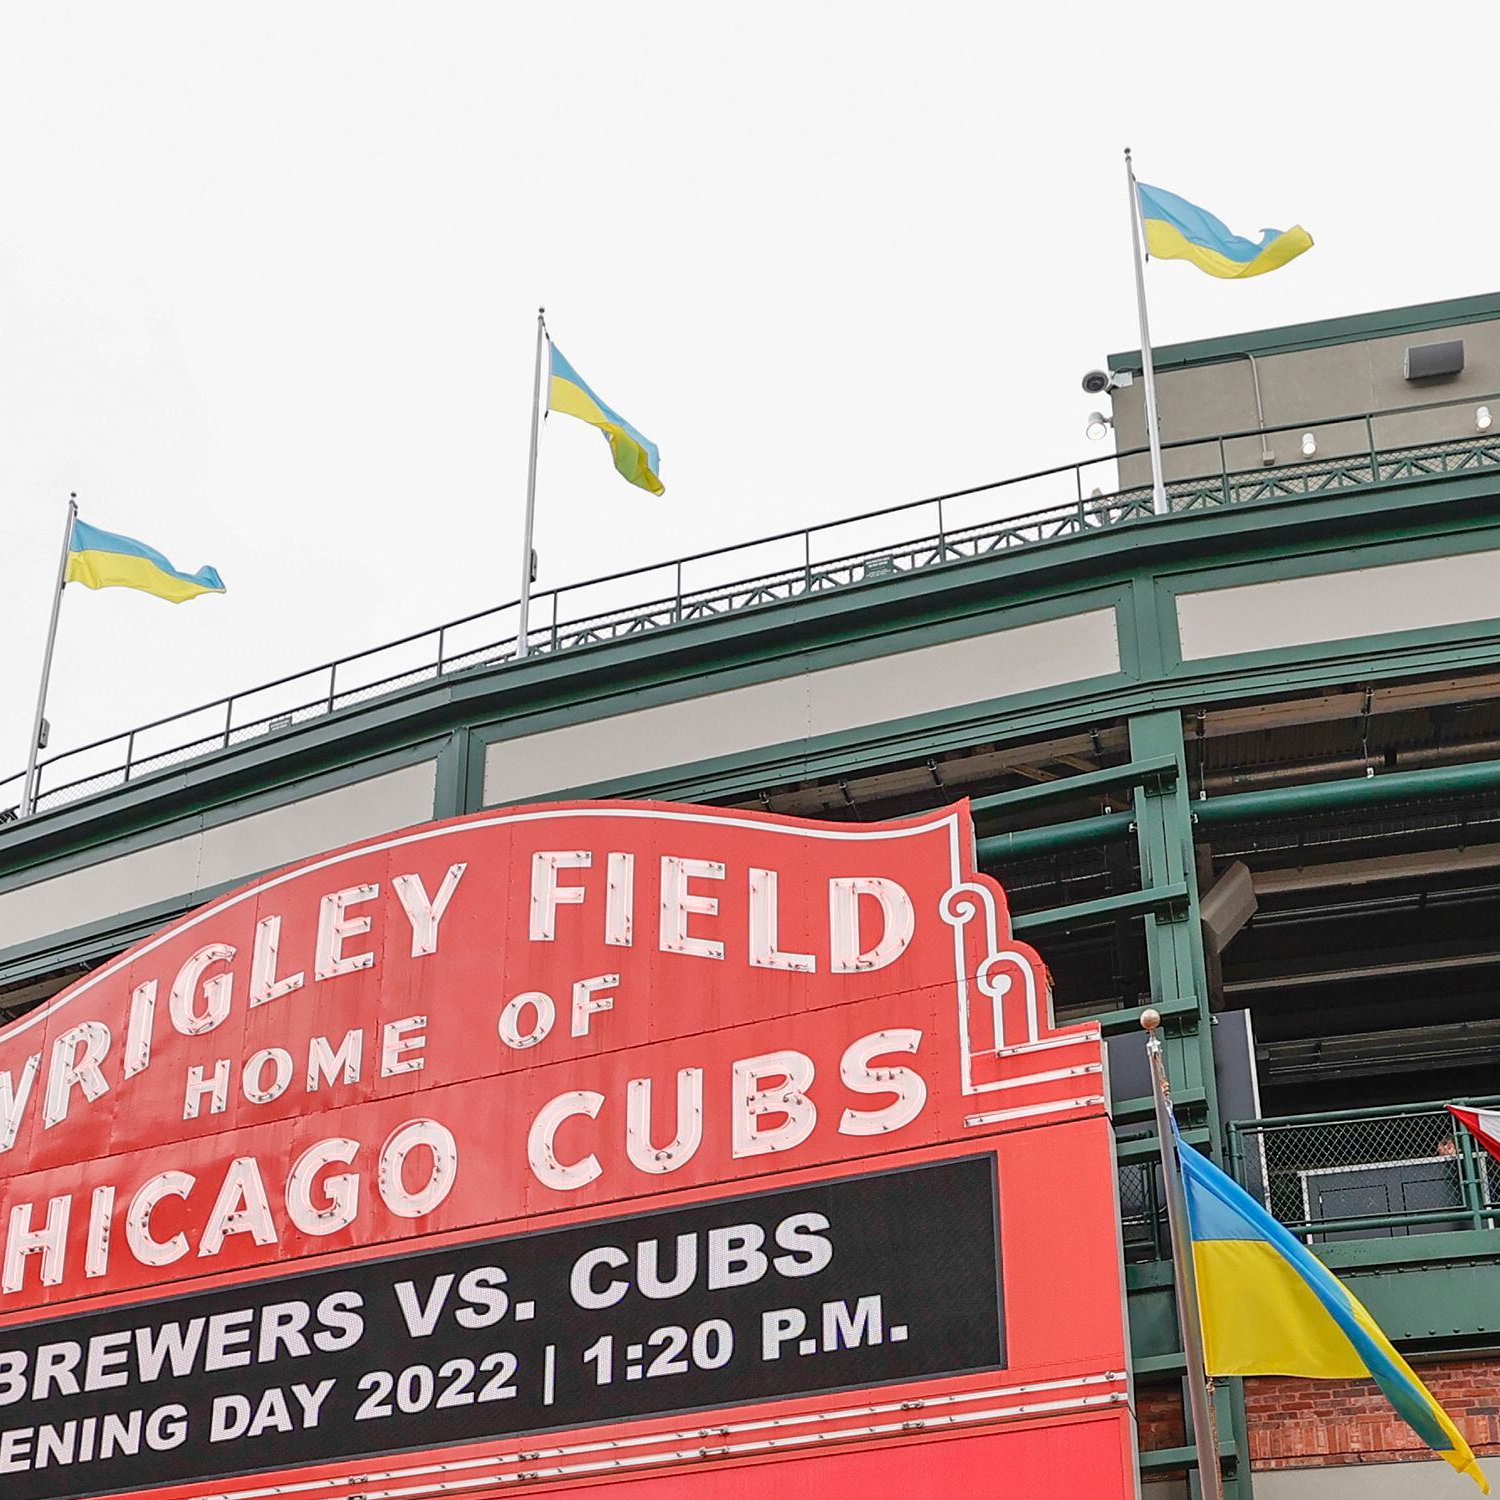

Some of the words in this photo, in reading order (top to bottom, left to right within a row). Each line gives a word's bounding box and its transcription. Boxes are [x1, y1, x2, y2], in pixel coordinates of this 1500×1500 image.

[528, 850, 917, 973] FIELD
[183, 1014, 428, 1120] HOME
[498, 973, 621, 1050] OF
[526, 1027, 929, 1192] CUBS
[393, 1265, 536, 1339] VS.
[570, 1211, 834, 1310] CUBS
[209, 1379, 338, 1444] DAY
[353, 1350, 518, 1422] 2022
[582, 1318, 735, 1386] 1:20
[762, 1294, 910, 1361] P.M.
